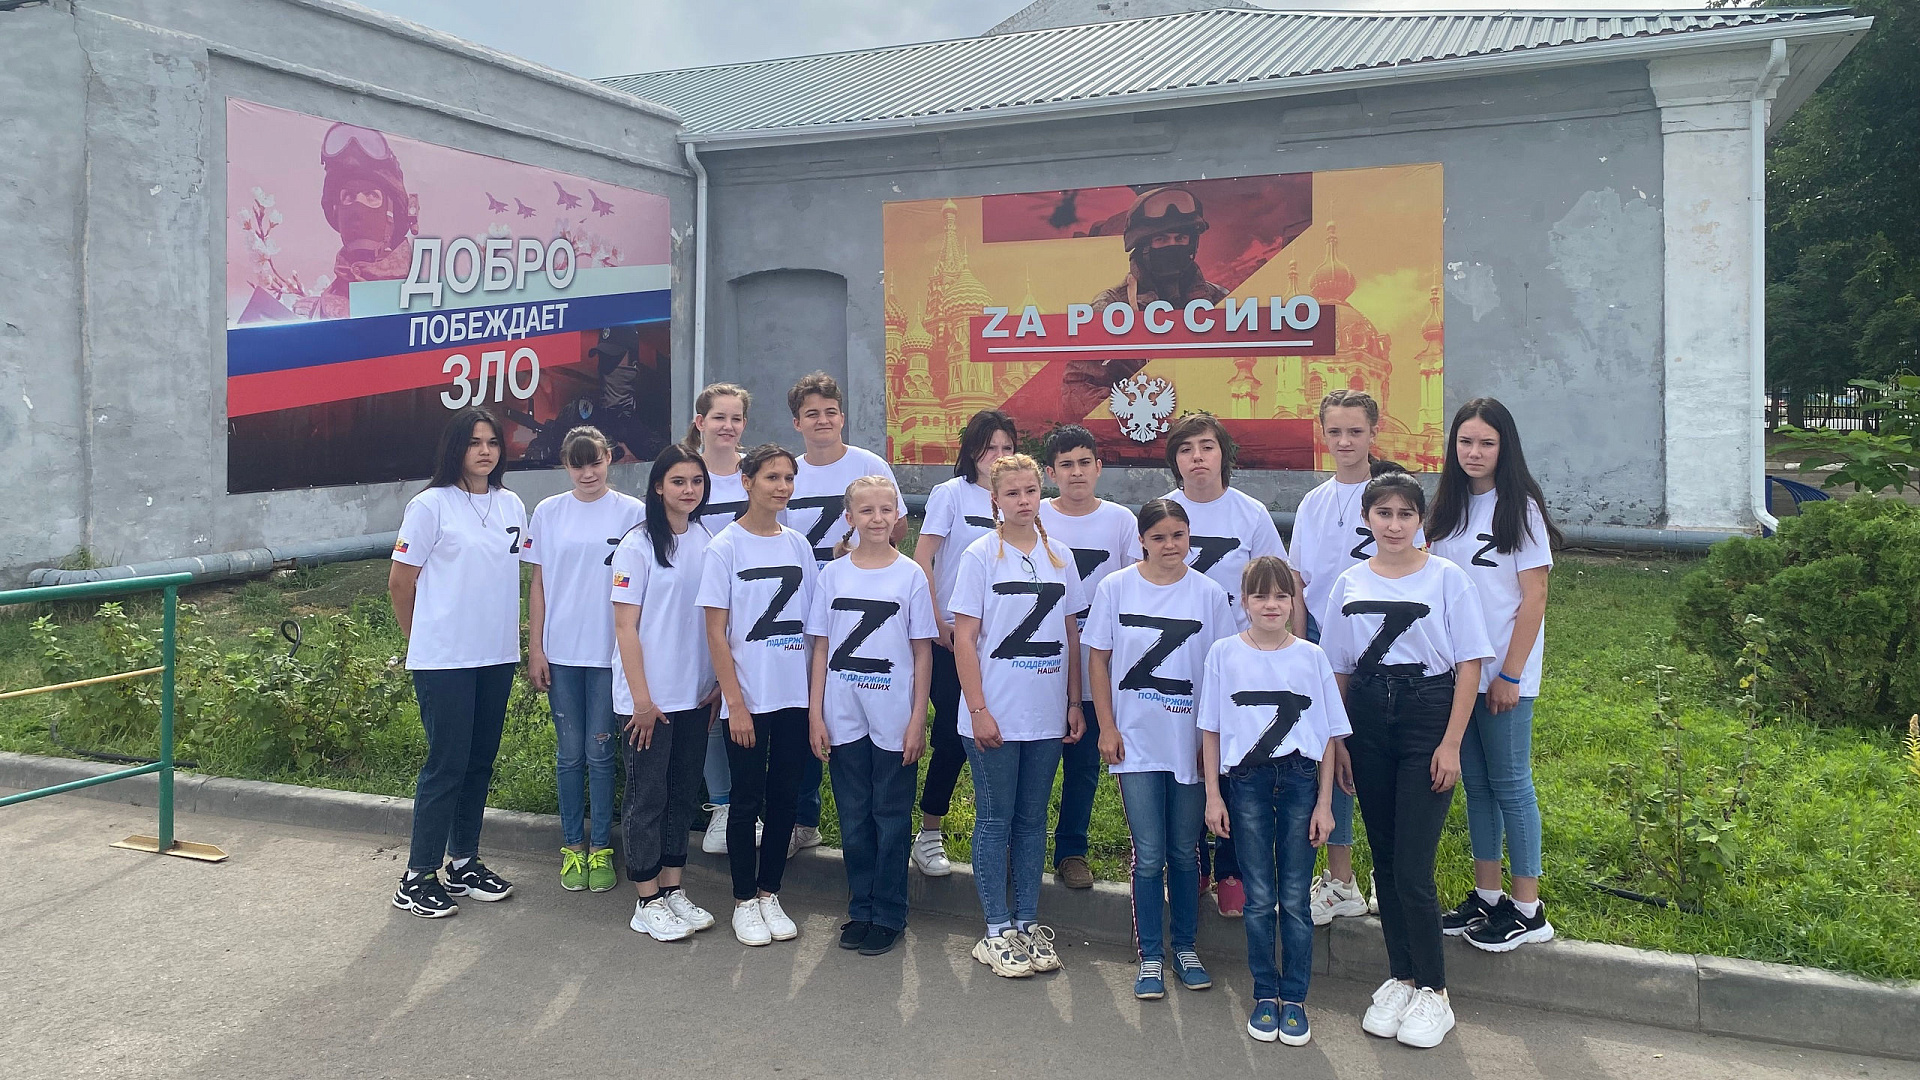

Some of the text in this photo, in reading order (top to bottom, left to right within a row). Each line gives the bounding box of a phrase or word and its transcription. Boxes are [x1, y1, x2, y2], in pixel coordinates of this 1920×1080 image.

[400, 237, 576, 309] ДОБРО
[409, 303, 569, 346] ПОБЕЖДАЕТ
[1067, 294, 1321, 336] РОССИЮ
[440, 347, 540, 410] ЗЛО
[505, 526, 521, 554] Z
[1350, 527, 1378, 561] Z
[1471, 533, 1499, 567] Z
[736, 565, 804, 642] Z
[990, 581, 1066, 660] Z
[829, 597, 901, 674] Z
[1119, 613, 1204, 695] Z
[1341, 600, 1431, 678] Z
[857, 682, 891, 691] НАШИХ
